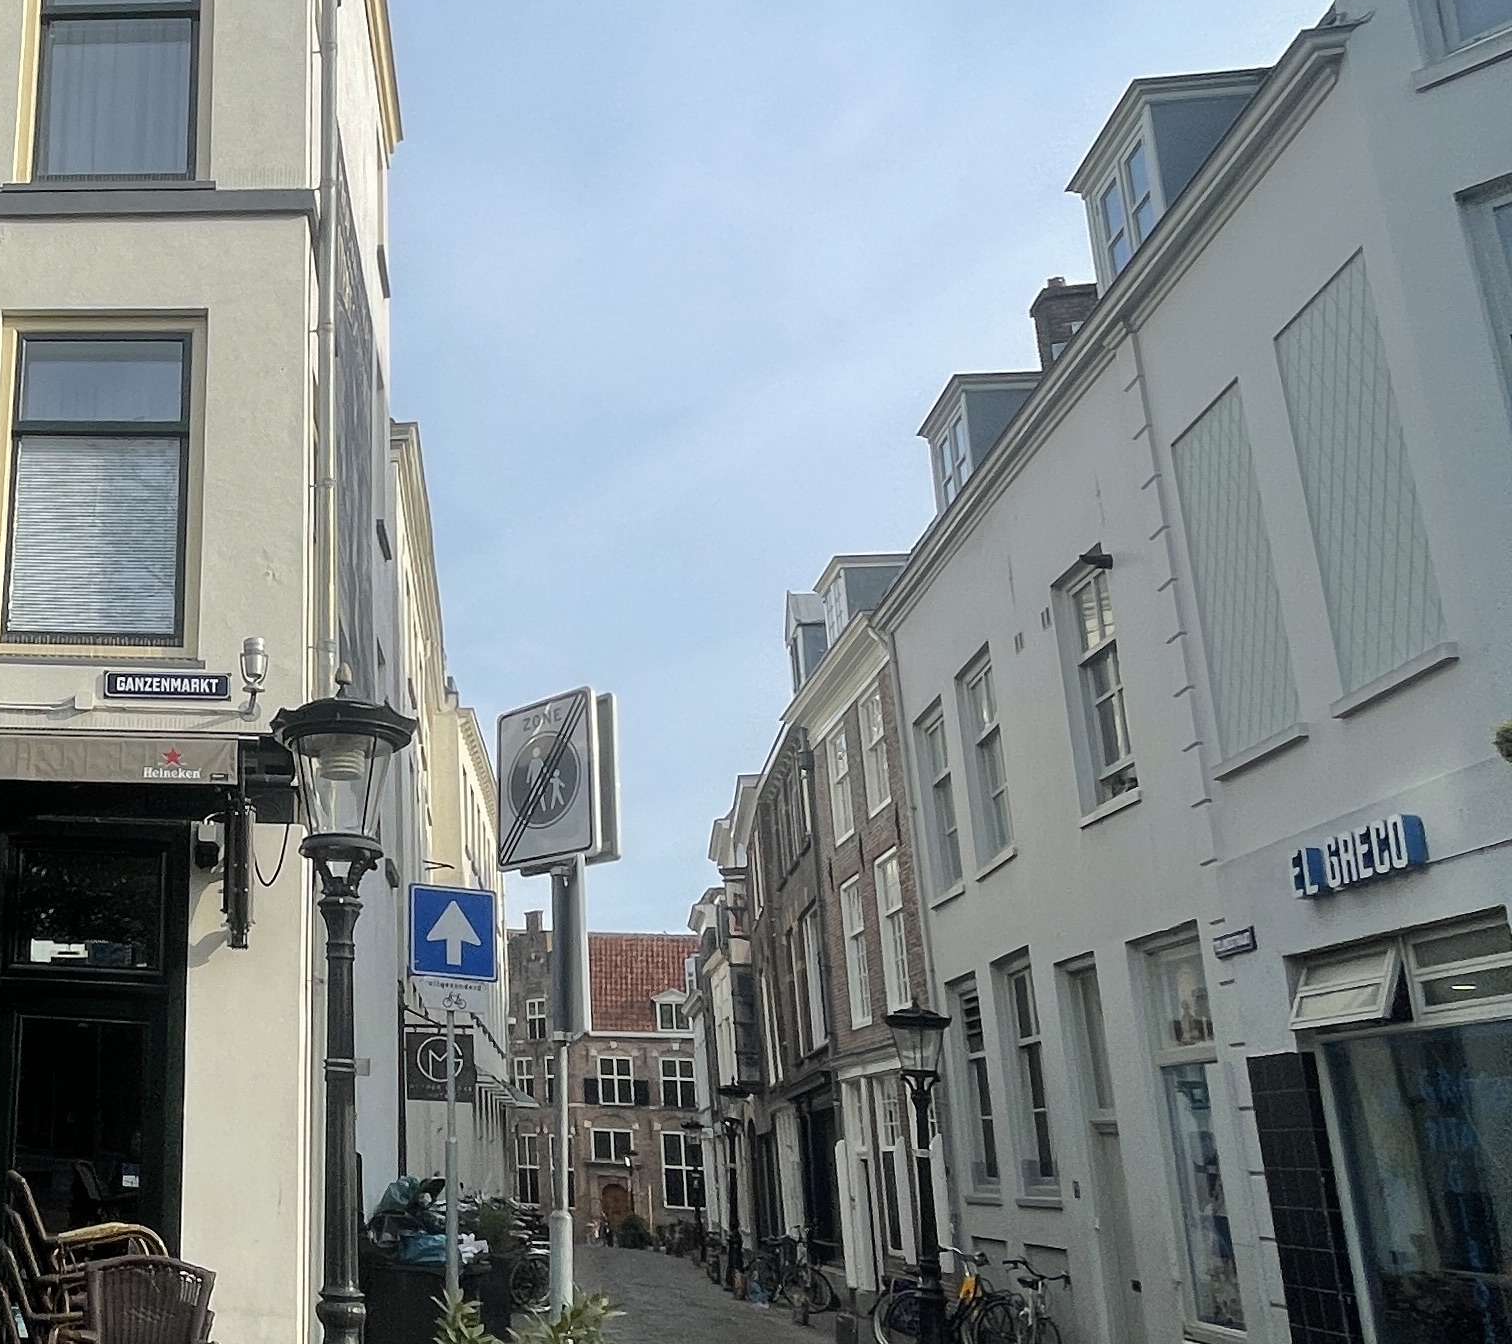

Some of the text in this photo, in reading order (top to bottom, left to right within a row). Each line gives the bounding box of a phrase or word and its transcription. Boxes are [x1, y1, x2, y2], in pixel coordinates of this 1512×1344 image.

[116, 676, 219, 693] GANZENMARKT
[522, 707, 562, 732] ZONE
[143, 766, 201, 779] Heineken
[1290, 846, 1319, 899] EL
